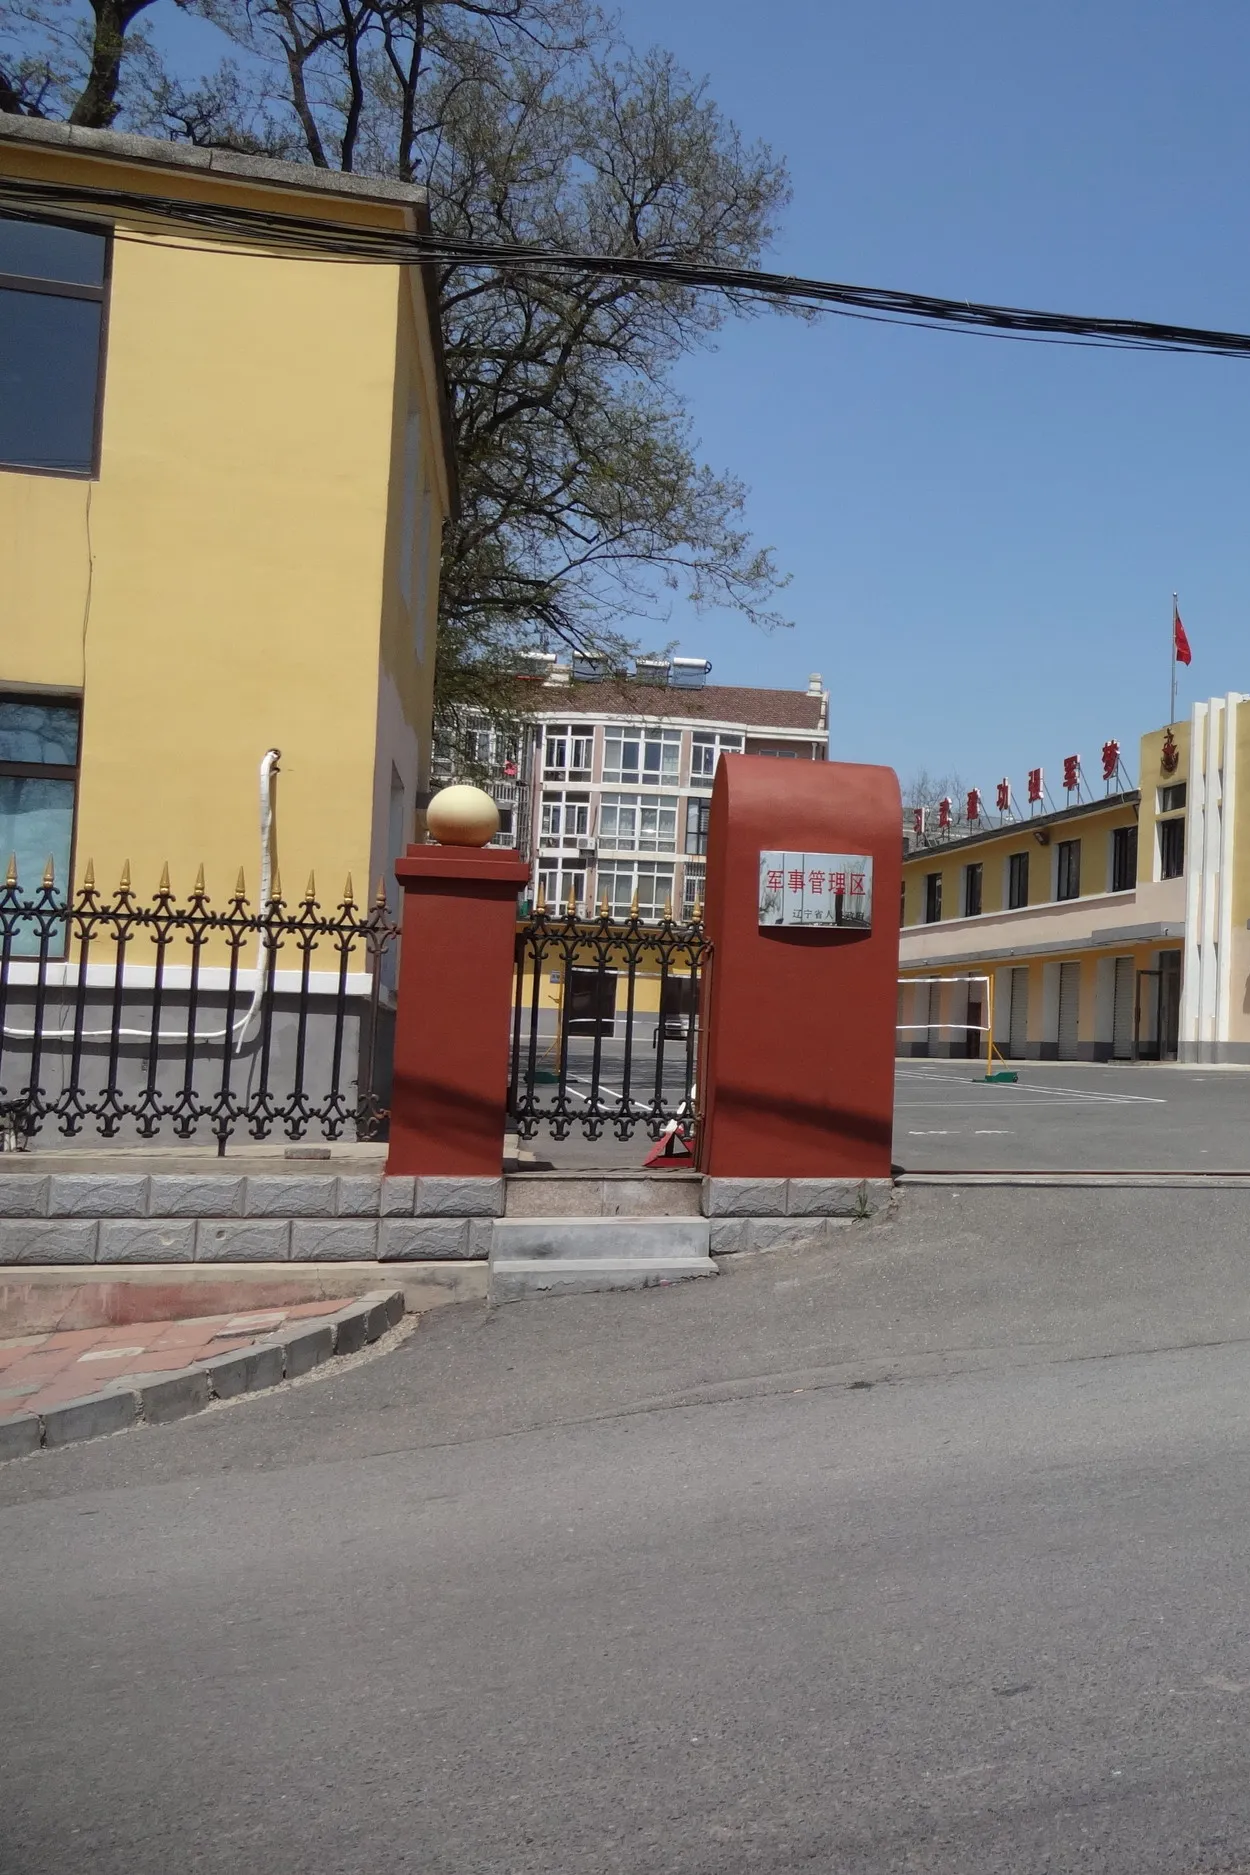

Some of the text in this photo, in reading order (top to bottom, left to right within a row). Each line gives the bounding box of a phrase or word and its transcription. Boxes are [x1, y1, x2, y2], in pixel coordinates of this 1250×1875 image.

[766, 868, 866, 896] 军事管理区
[792, 908, 865, 921] 辽宁省人政府
